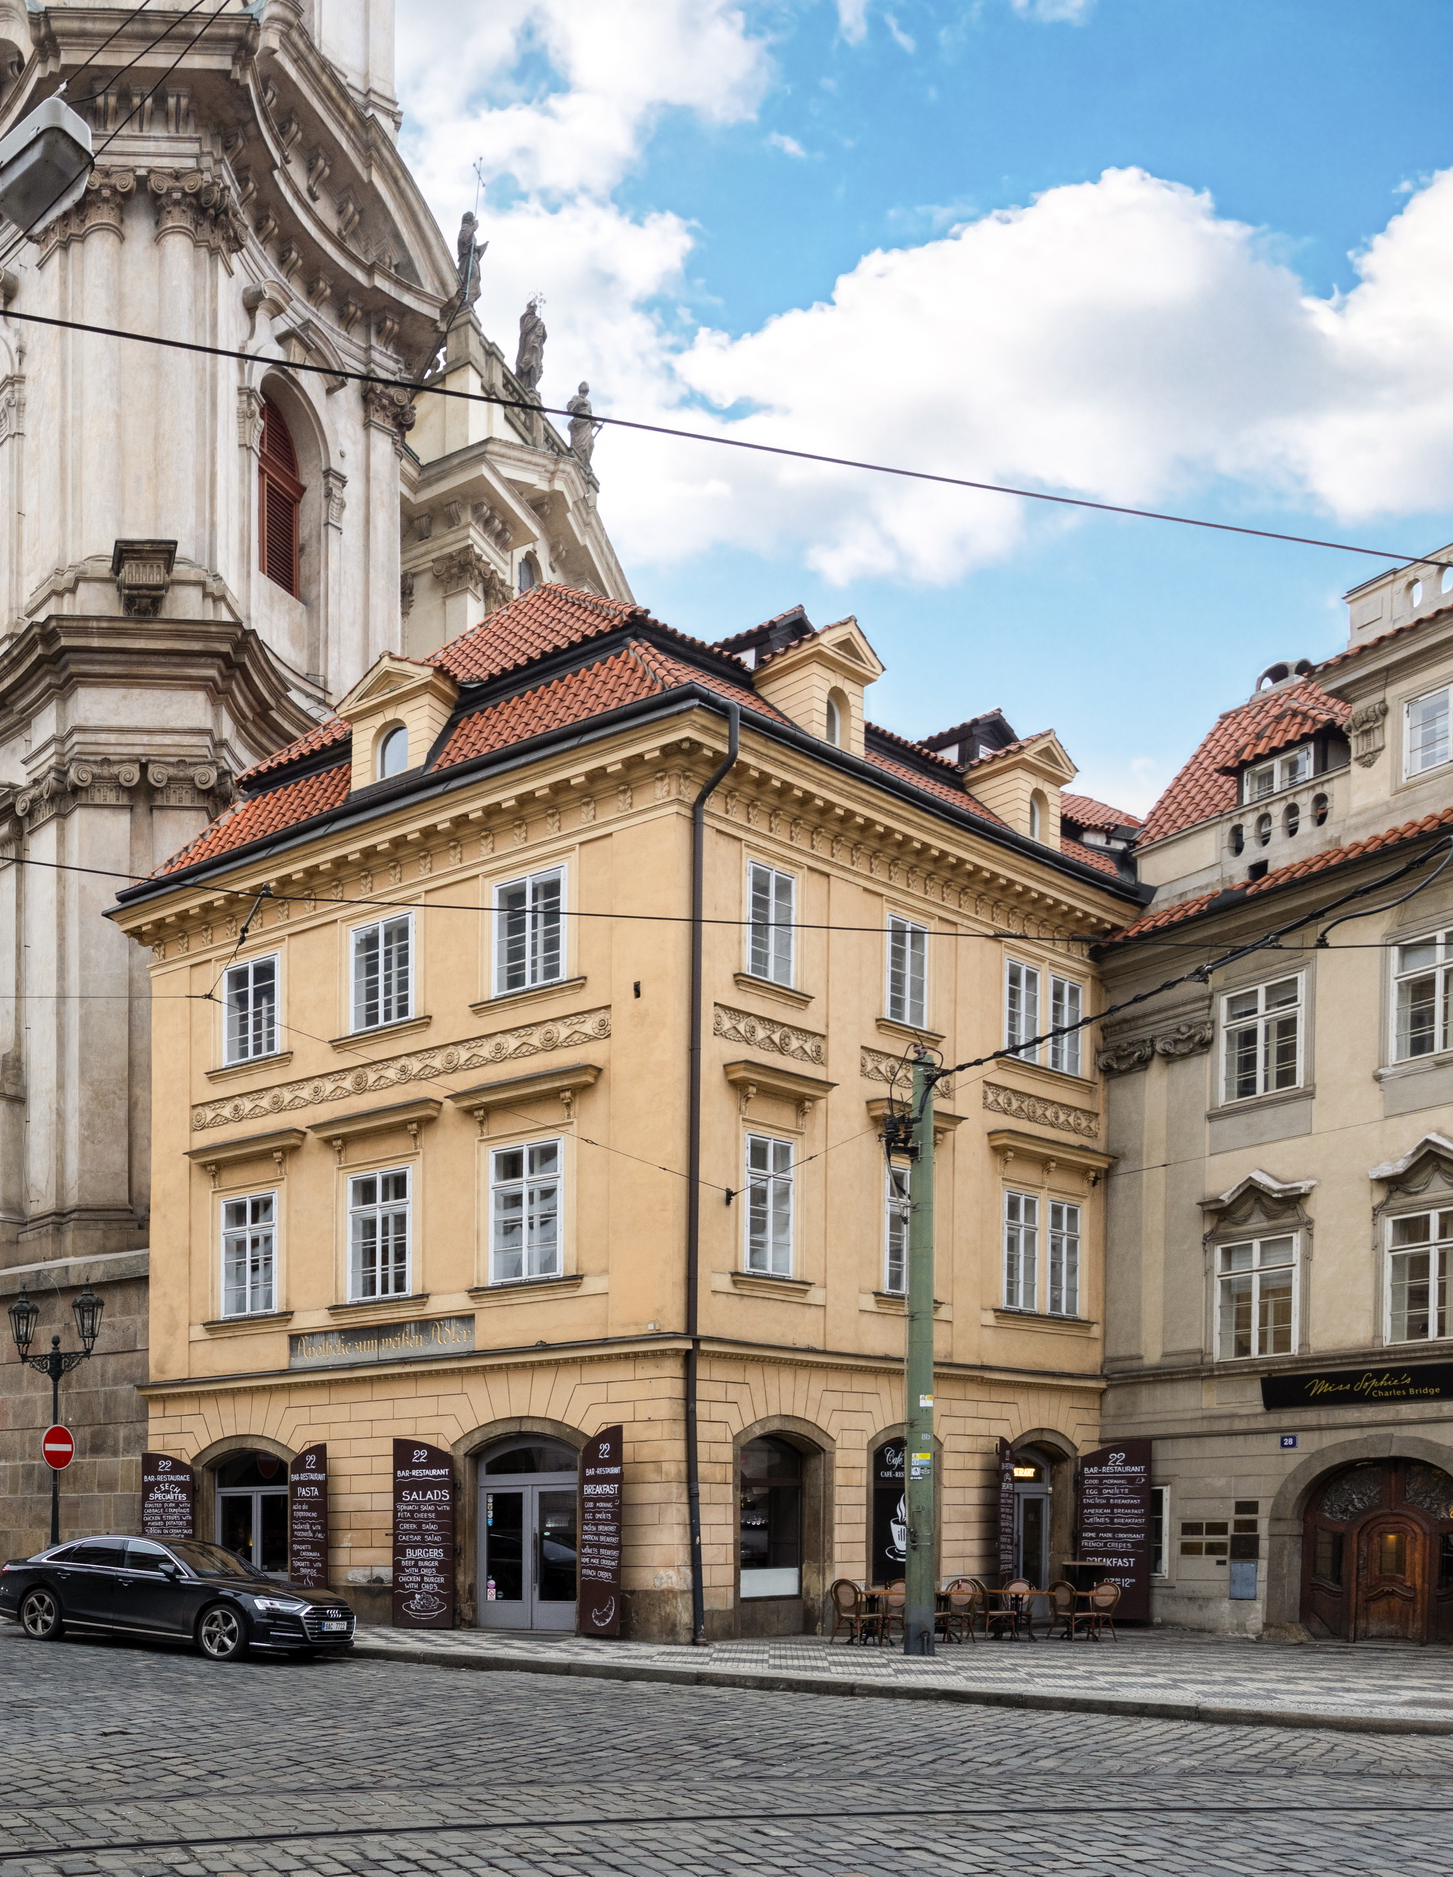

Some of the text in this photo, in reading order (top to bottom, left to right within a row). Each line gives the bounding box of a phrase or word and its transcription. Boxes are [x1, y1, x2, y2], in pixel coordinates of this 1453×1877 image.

[1304, 1372, 1412, 1397] Miss Sophie's
[1371, 1386, 1441, 1397] Charles Bridge
[1283, 1437, 1294, 1446] 28
[412, 1449, 428, 1463] 22
[598, 1443, 610, 1458] 22
[306, 1455, 316, 1468] 22
[1108, 1453, 1126, 1465] 22
[158, 1460, 172, 1472] 22
[1084, 1466, 1145, 1474] BAR-RESTAURANT
[298, 1487, 319, 1496] PASTA
[402, 1489, 450, 1501] SALADS
[583, 1485, 619, 1495] BREAKFAST
[406, 1548, 444, 1557] BURGERS
